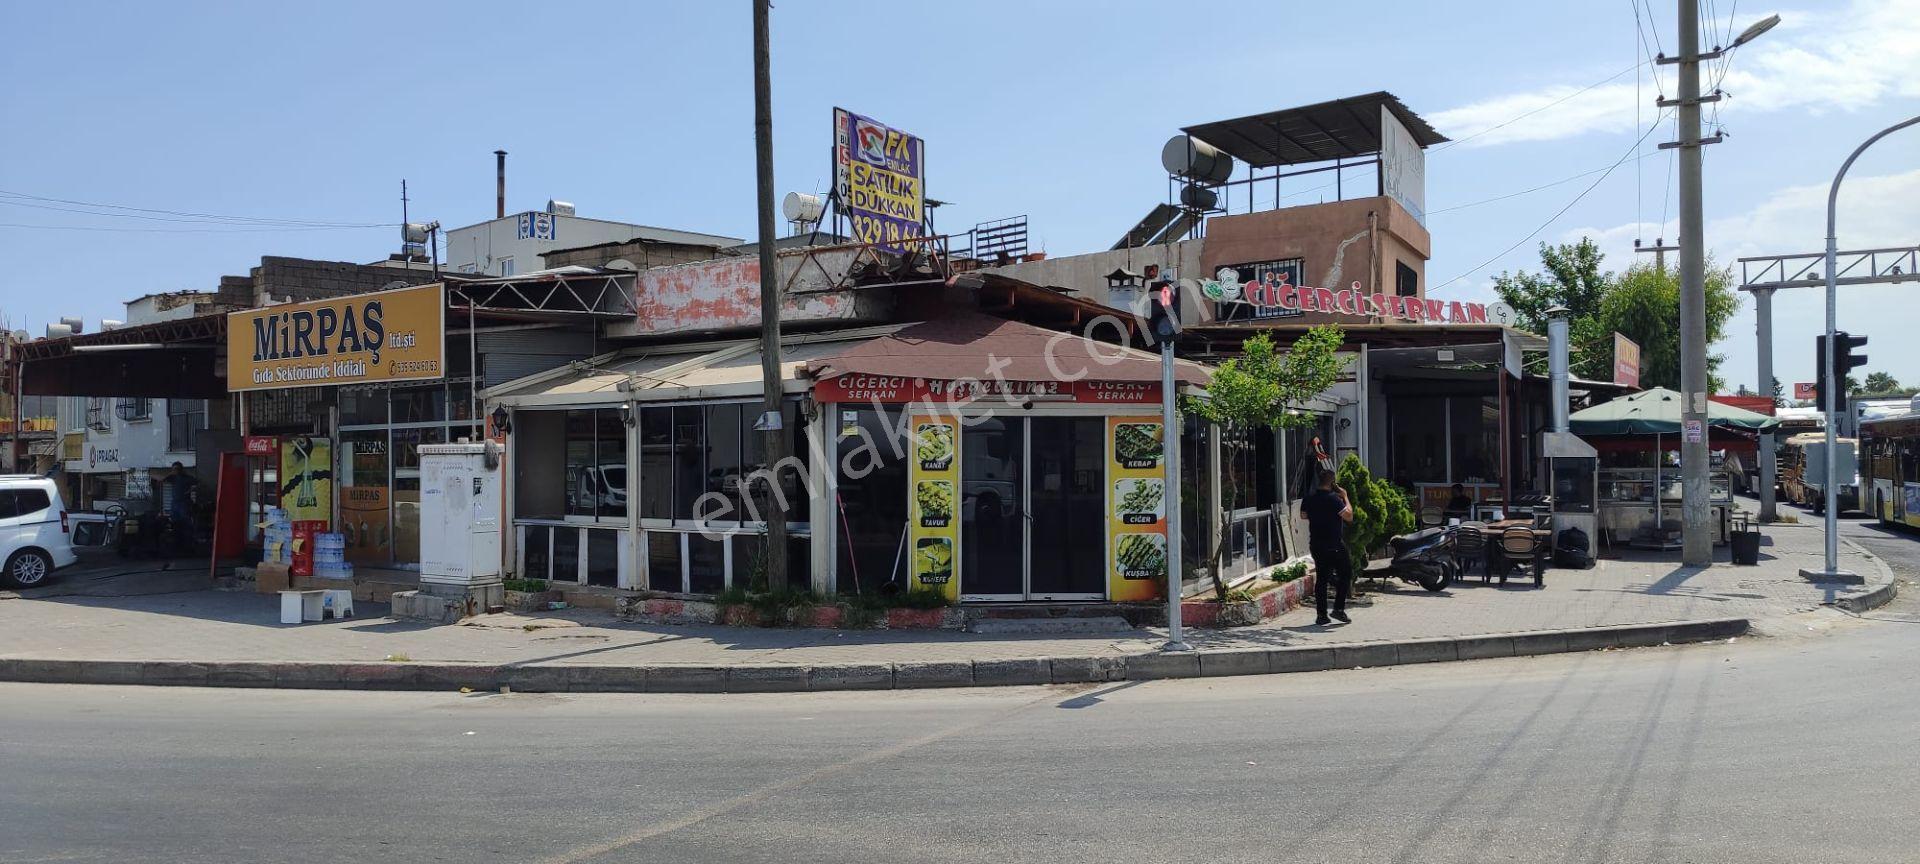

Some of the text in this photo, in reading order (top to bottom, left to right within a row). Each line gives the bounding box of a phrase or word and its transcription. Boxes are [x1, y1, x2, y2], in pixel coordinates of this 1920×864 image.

[886, 158, 912, 174] EMLAK
[854, 165, 915, 199] SATILIK
[855, 189, 916, 219] DÜKKAN
[1369, 292, 1487, 323] SERKAN
[276, 363, 330, 382] Sektöründe
[848, 390, 896, 399] SERKAN
[1097, 391, 1144, 400] SERKAN
[1128, 460, 1152, 468] KEBAP
